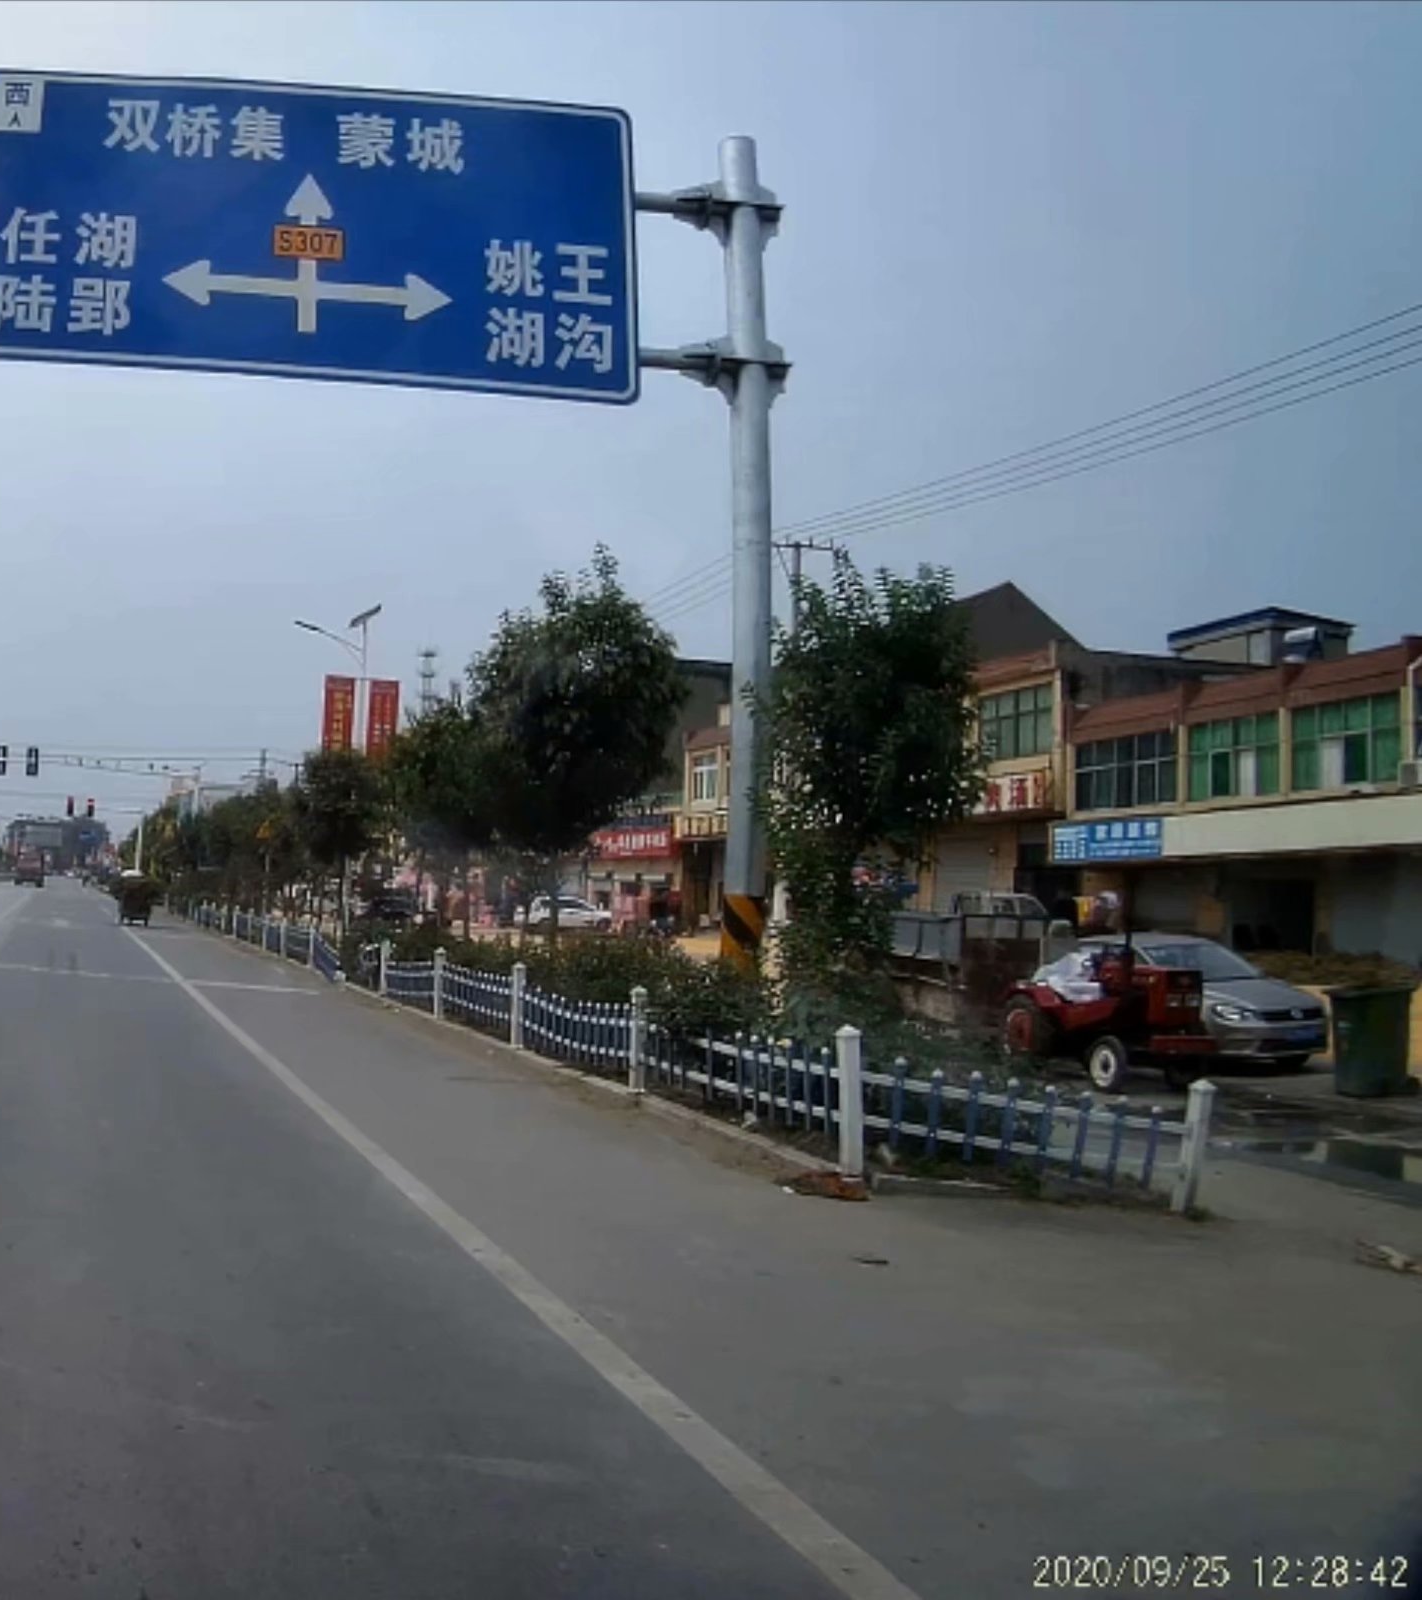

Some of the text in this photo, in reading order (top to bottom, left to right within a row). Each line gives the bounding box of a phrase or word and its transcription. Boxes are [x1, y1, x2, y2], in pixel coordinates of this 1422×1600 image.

[5, 82, 33, 107] 西
[104, 98, 285, 161] 双桥集
[336, 112, 465, 174] 蒙城
[277, 229, 339, 256] S307
